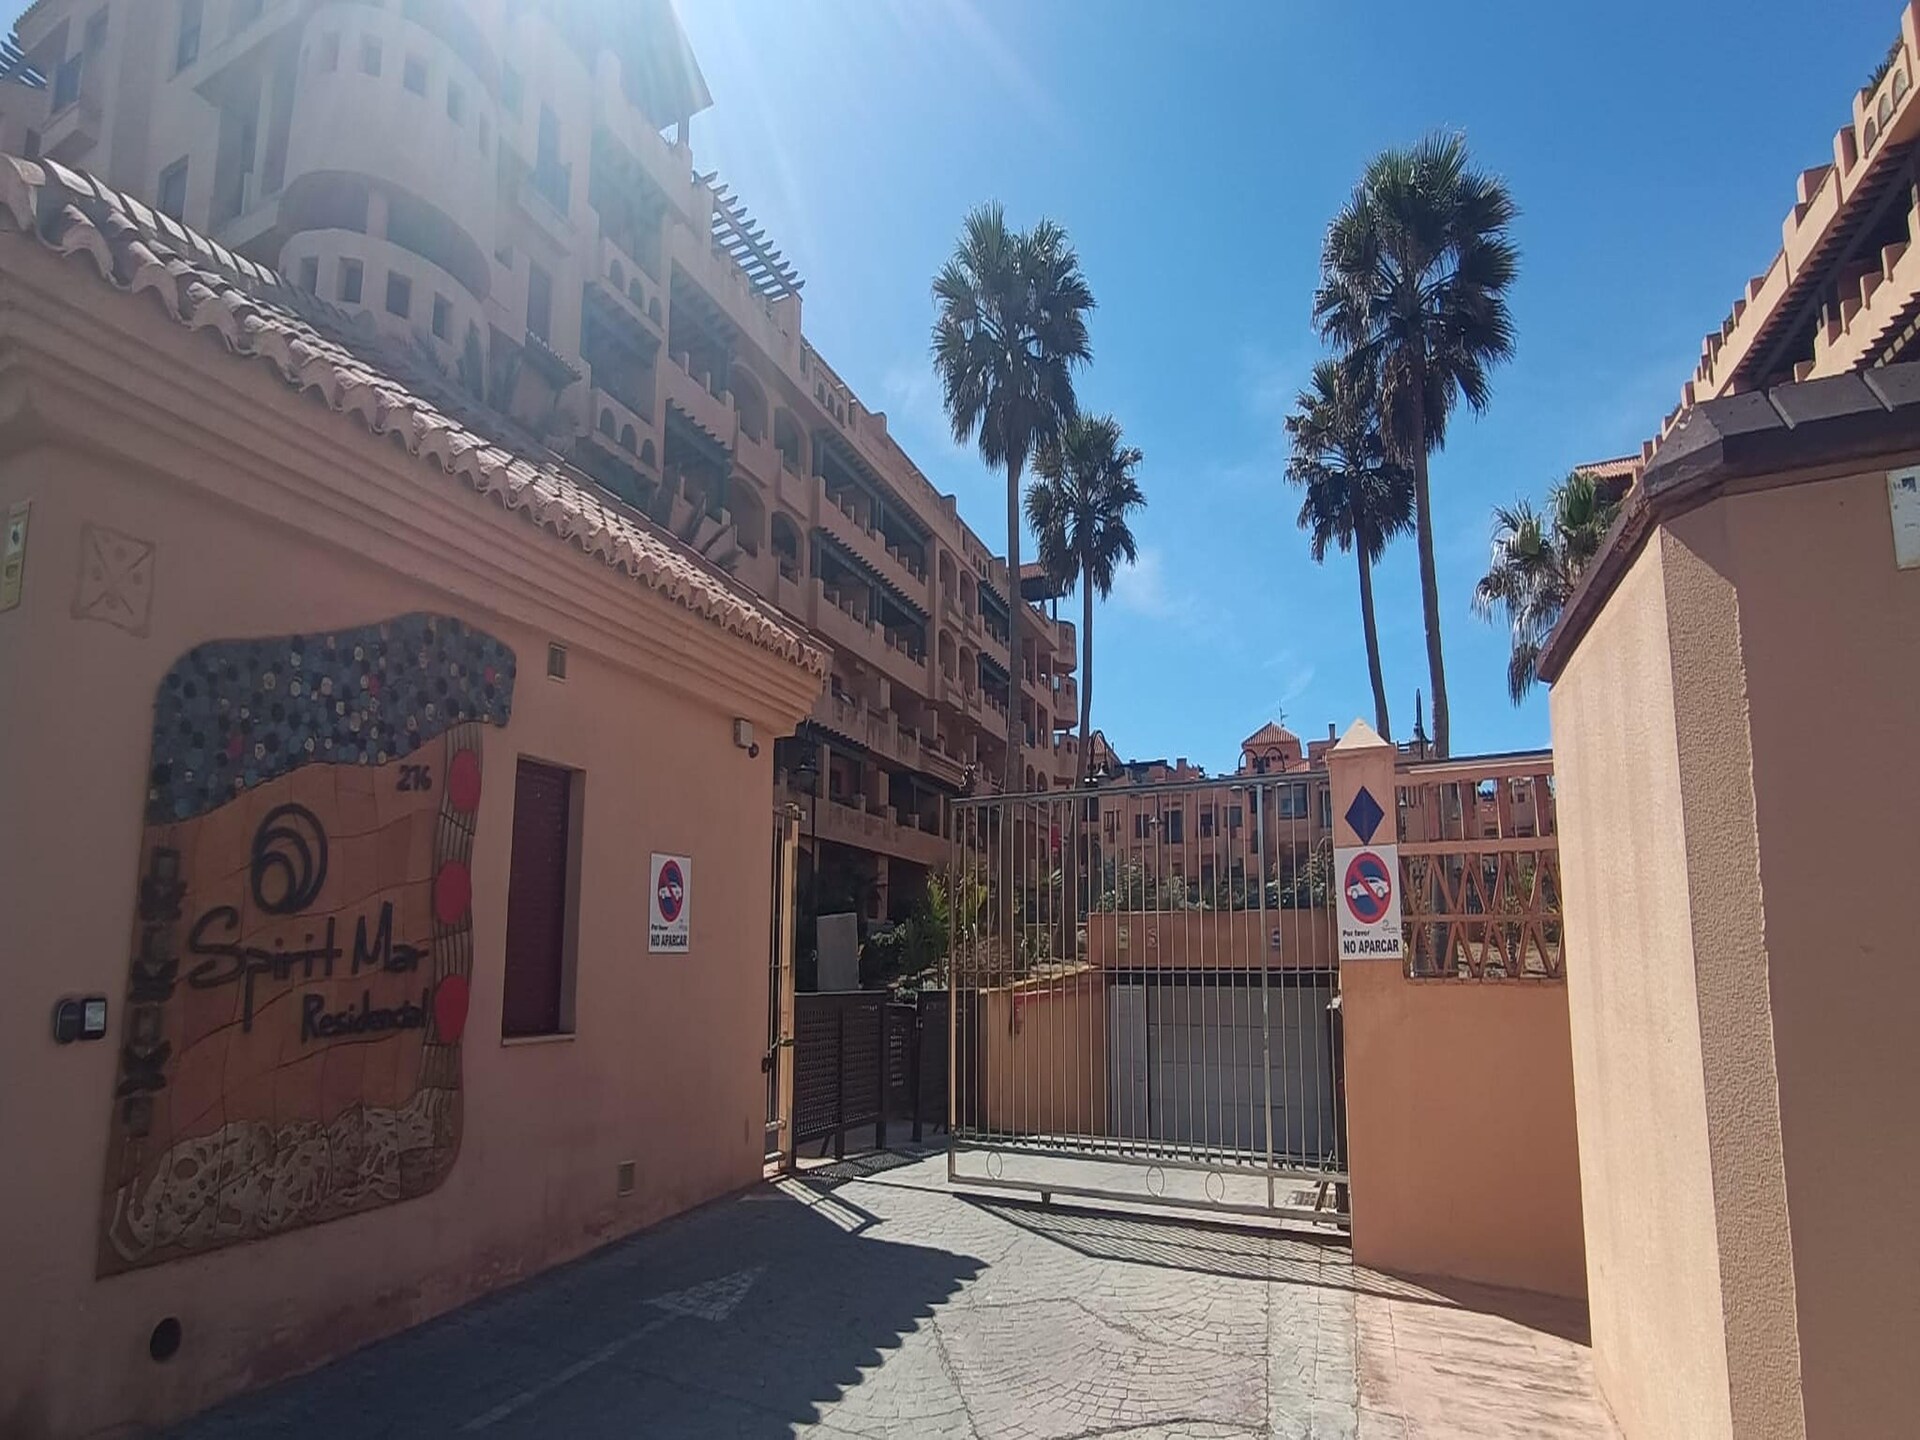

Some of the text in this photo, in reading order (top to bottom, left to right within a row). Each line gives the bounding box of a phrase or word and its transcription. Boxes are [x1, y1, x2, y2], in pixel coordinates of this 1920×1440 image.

[650, 934, 687, 947] NO APARCAR
[1343, 939, 1399, 954] NO APARCAR
[189, 901, 429, 1034] Spirit Mar
[301, 988, 429, 1043] Residencial
